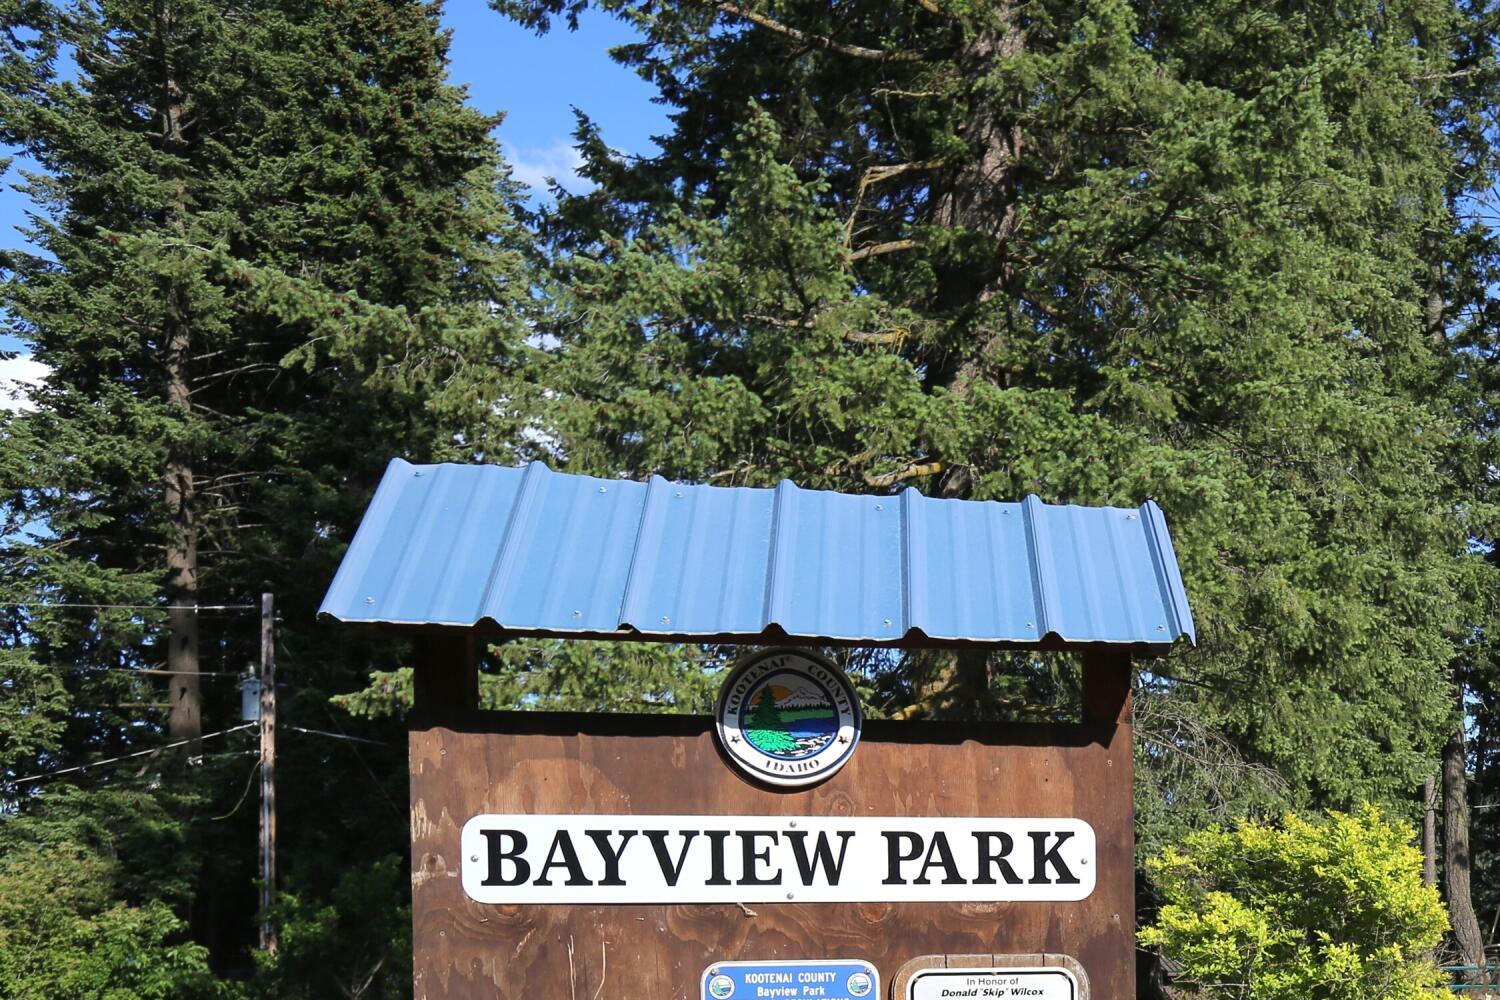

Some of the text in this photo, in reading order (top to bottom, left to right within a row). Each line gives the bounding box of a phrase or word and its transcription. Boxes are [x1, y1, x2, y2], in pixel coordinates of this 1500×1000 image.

[727, 656, 851, 716] KOOTENAI COUNTY
[765, 758, 820, 774] IDAHO
[480, 829, 1080, 887] BAYVIEW PARK
[745, 972, 836, 984] KOOTENAI COUNTY
[966, 977, 1019, 986] In Honor of
[757, 985, 825, 998] Bayview Park
[941, 988, 1044, 998] Donald "Skip" Wilcox
